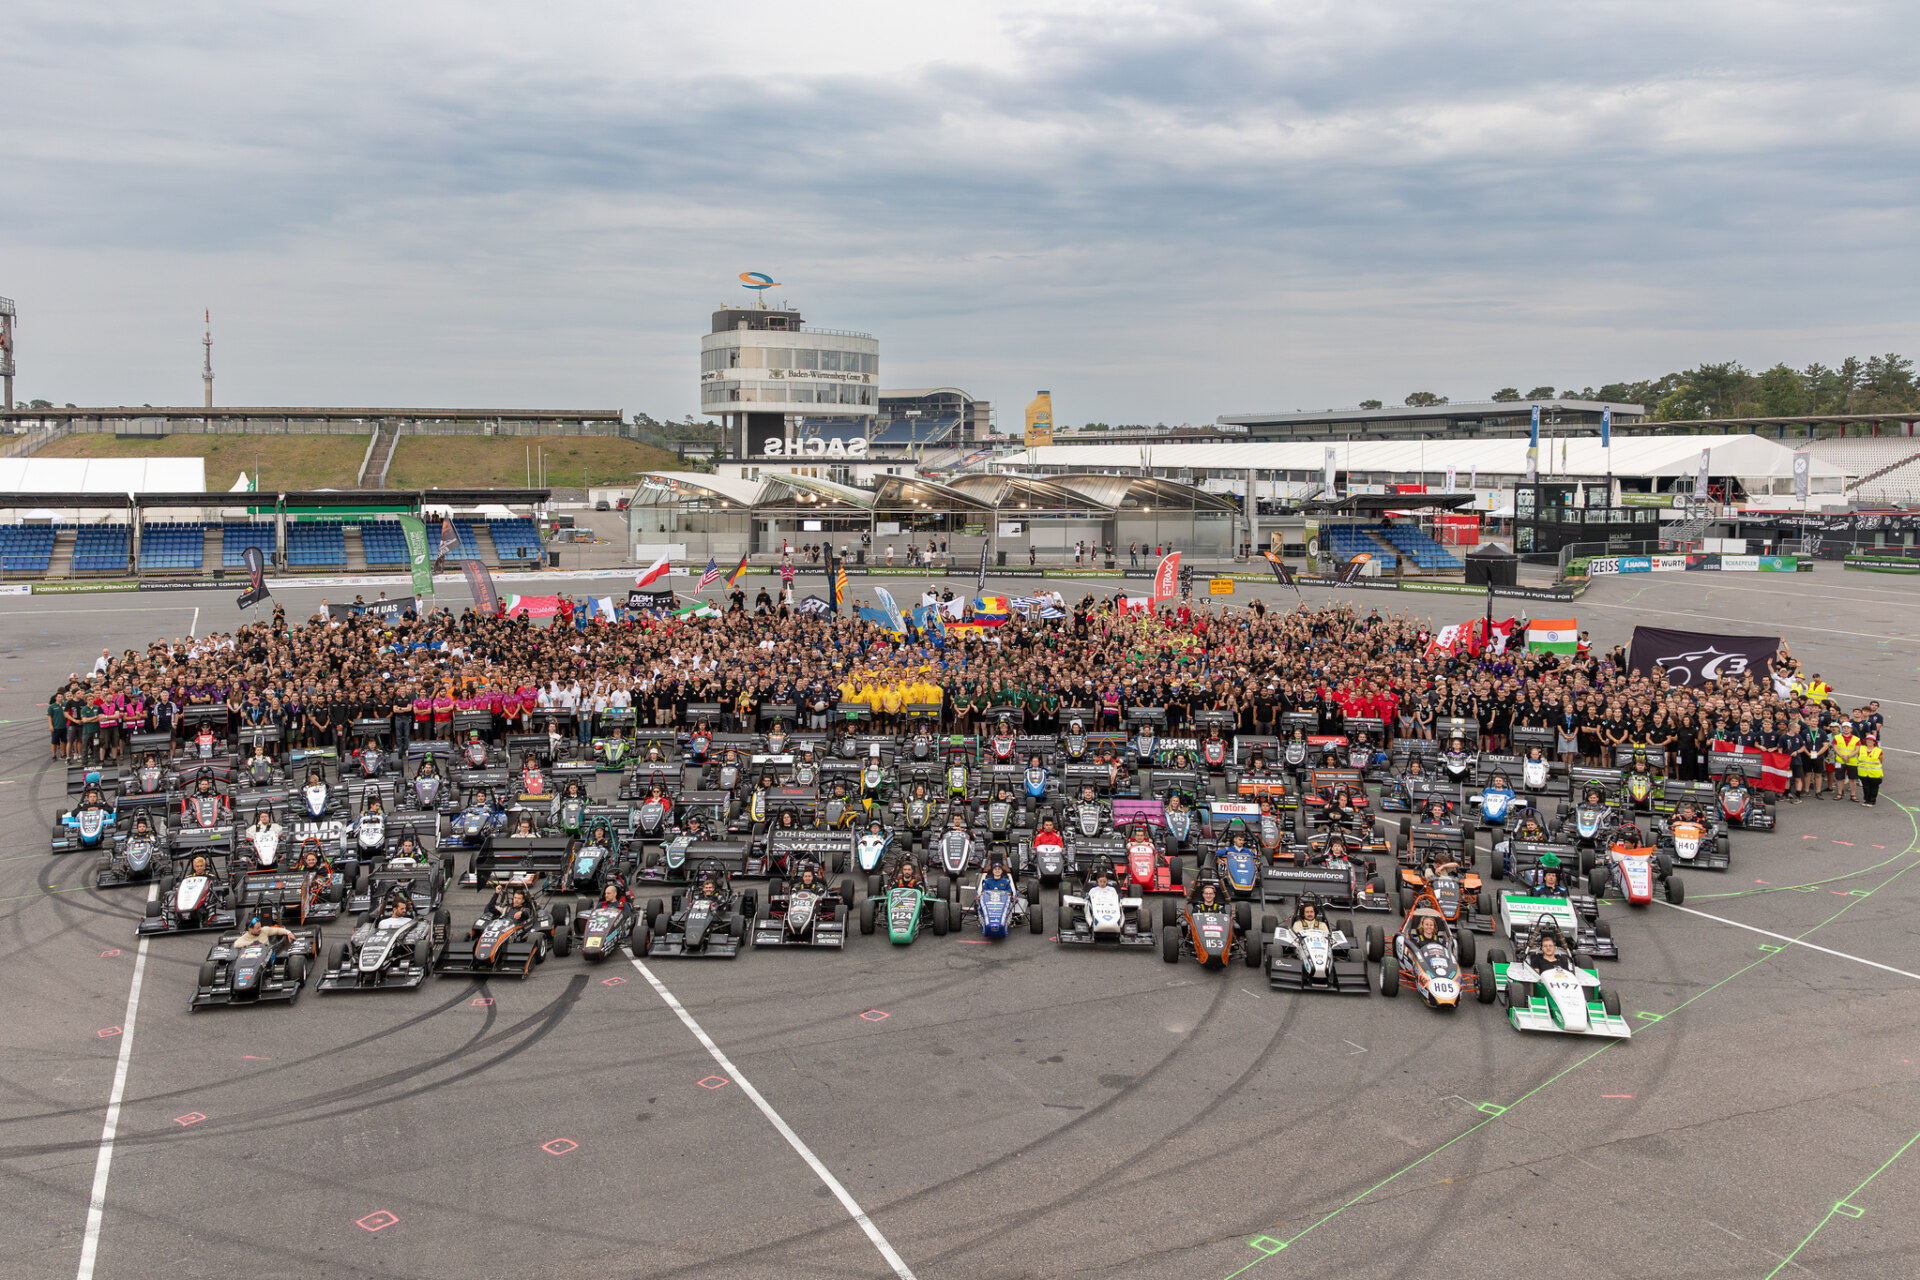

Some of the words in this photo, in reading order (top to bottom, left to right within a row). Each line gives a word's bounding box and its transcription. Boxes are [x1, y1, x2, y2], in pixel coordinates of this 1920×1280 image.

[788, 369, 846, 381] Baden-Württemberg
[847, 370, 861, 380] Center
[1594, 560, 1619, 572] ZEISS
[1661, 559, 1684, 568] WÜRTH
[1162, 560, 1174, 596] E-TRAXX
[380, 604, 398, 612] UAS
[1220, 804, 1247, 812] rotork
[1678, 842, 1694, 850] H40
[1268, 870, 1344, 880] #farewelldownforce
[1510, 904, 1562, 912] SCHAEFFLER
[892, 912, 912, 920] H24
[1206, 940, 1224, 948] H53
[1434, 982, 1454, 992] H05
[1550, 982, 1578, 990] H97
